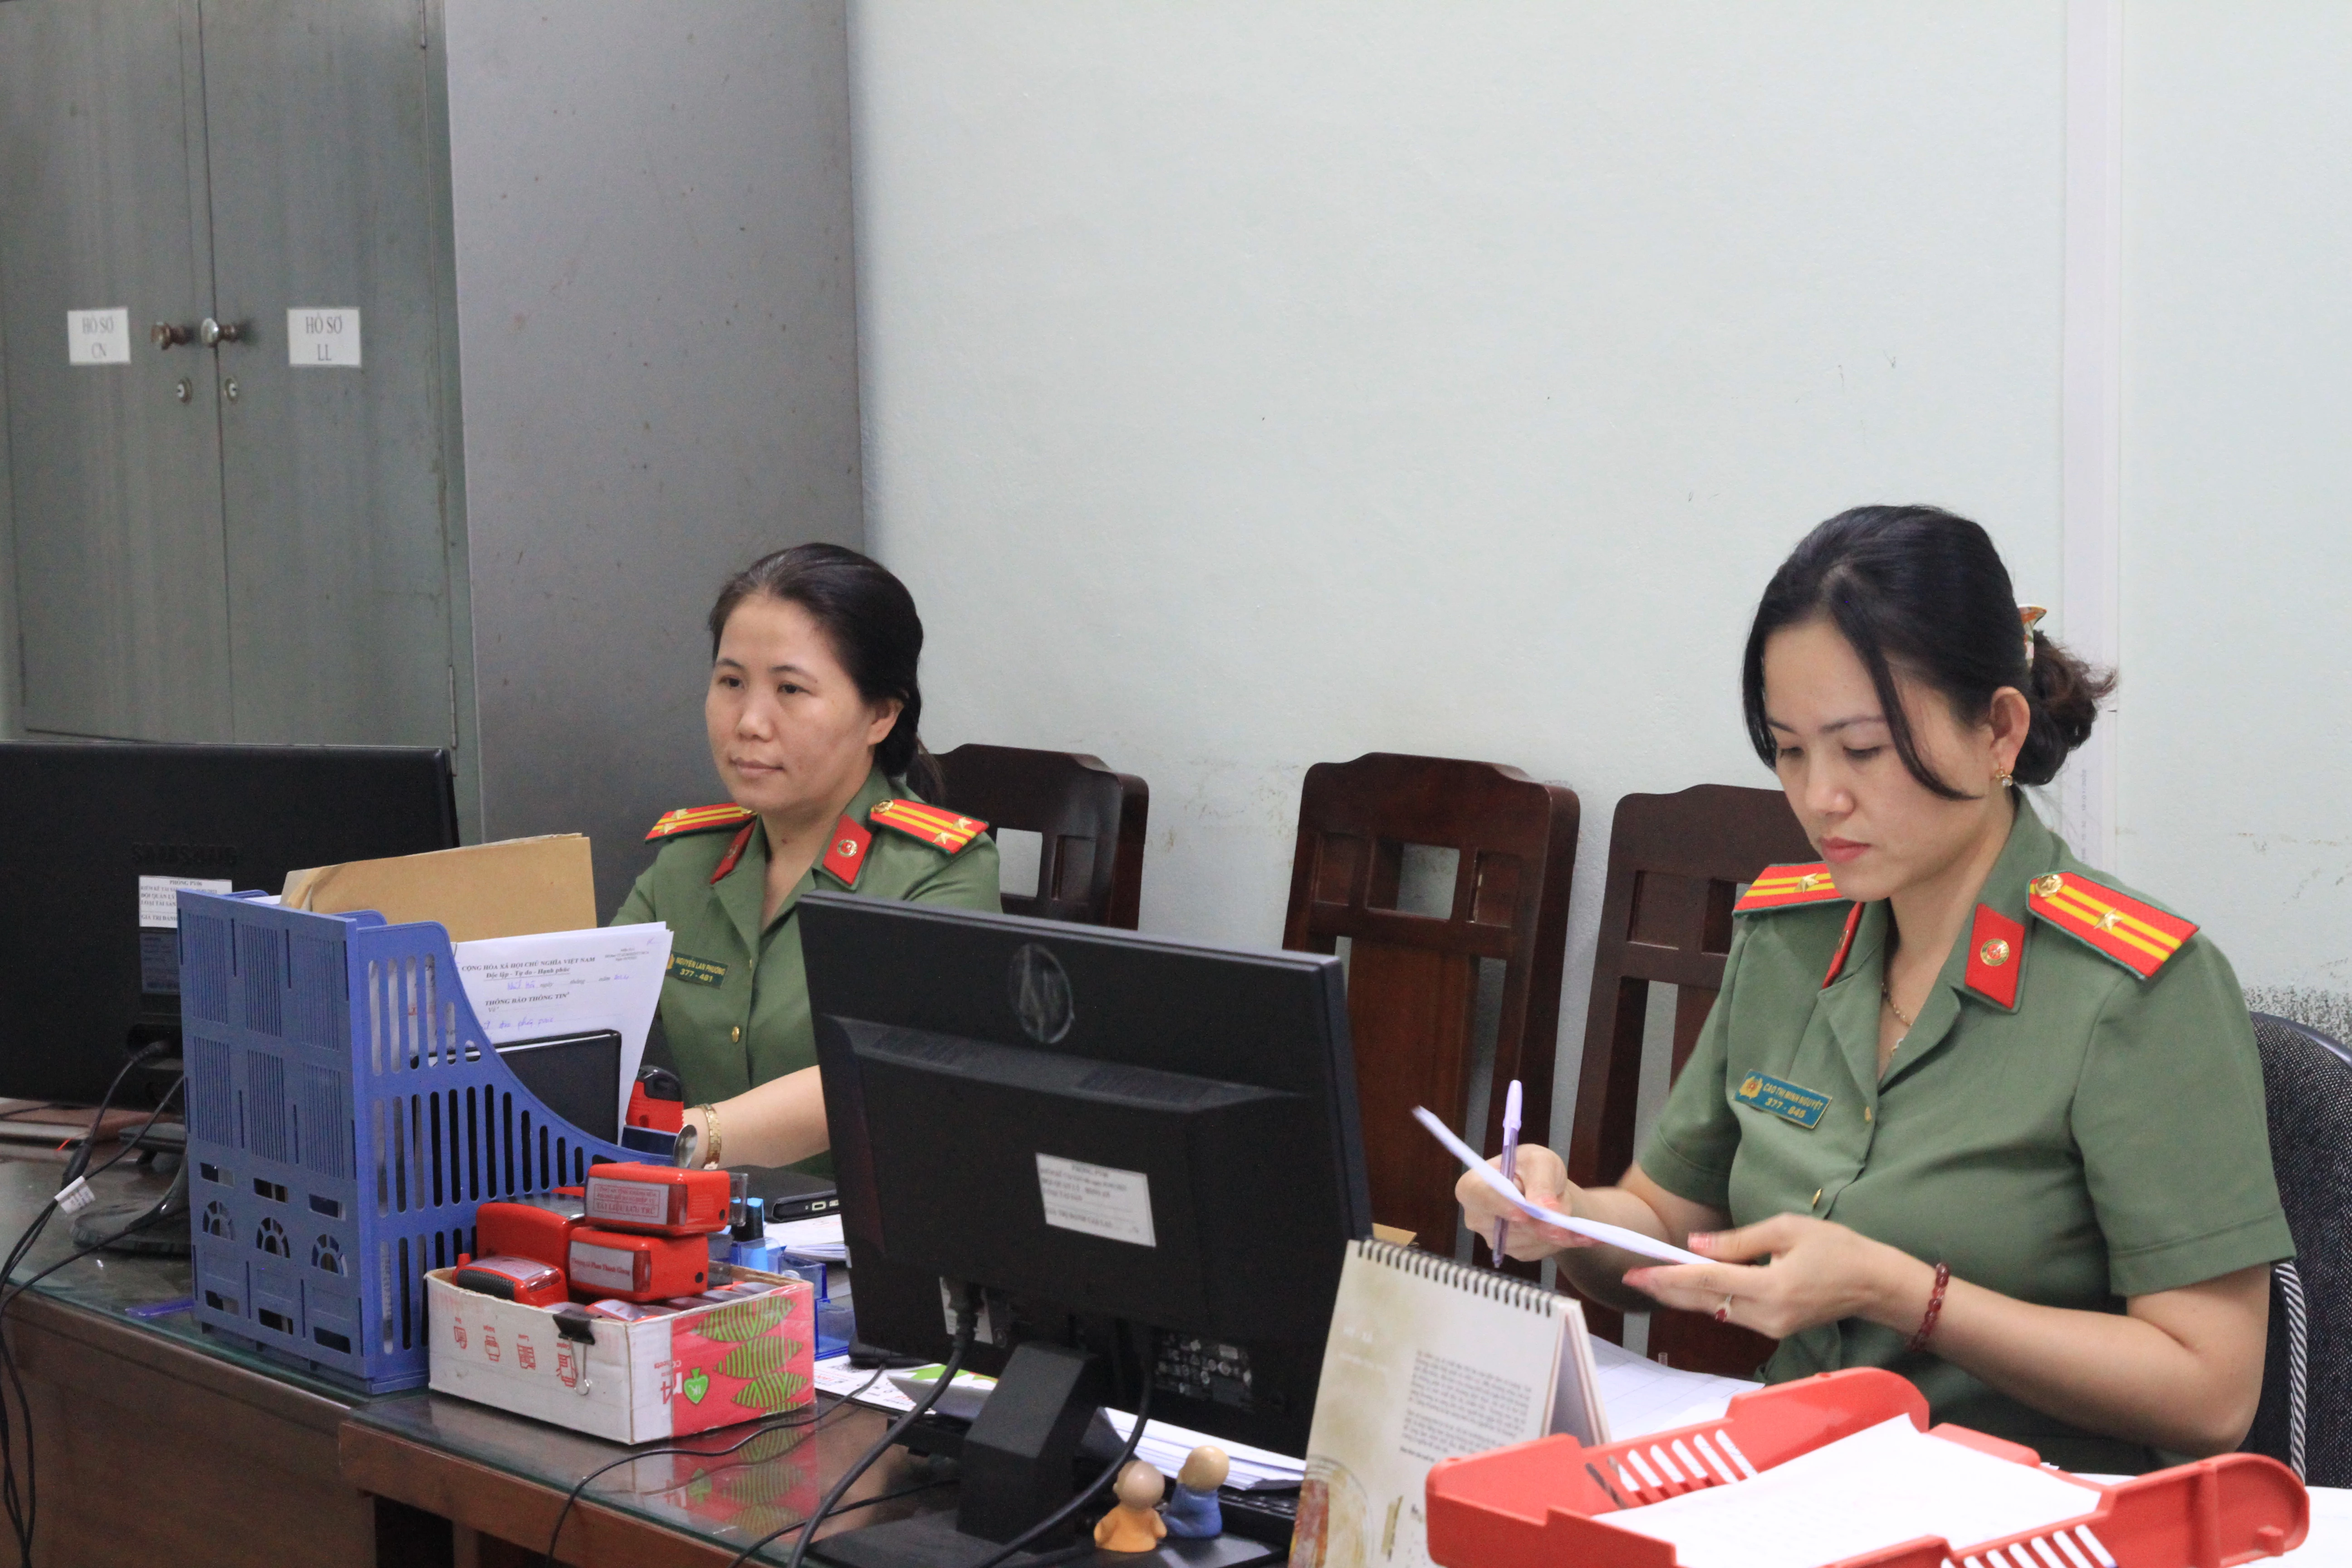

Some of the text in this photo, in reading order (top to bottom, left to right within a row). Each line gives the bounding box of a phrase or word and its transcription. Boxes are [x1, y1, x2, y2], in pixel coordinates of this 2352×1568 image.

[318, 344, 331, 361] LL
[680, 968, 695, 977] 377
[1763, 1083, 1777, 1093] CAO
[1765, 1098, 1783, 1109] 377
